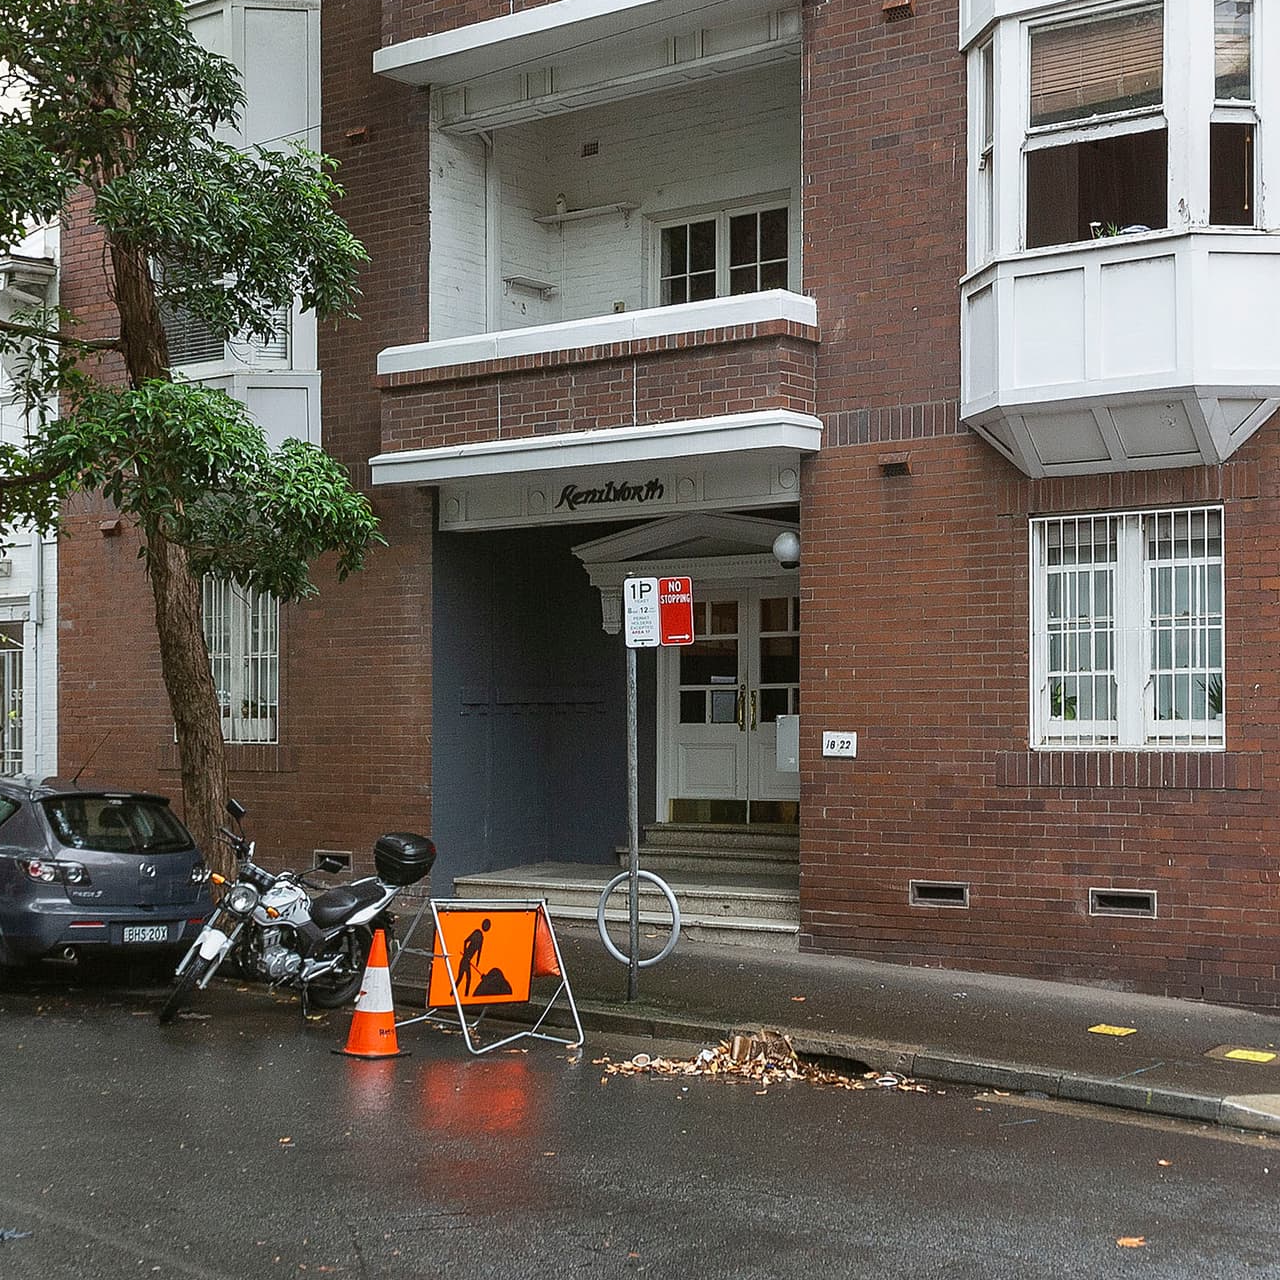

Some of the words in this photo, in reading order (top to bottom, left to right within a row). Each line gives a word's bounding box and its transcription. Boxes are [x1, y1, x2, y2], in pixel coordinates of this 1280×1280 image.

[630, 582, 652, 599] 1P
[668, 581, 682, 592] NO
[660, 594, 690, 604] STOPPING
